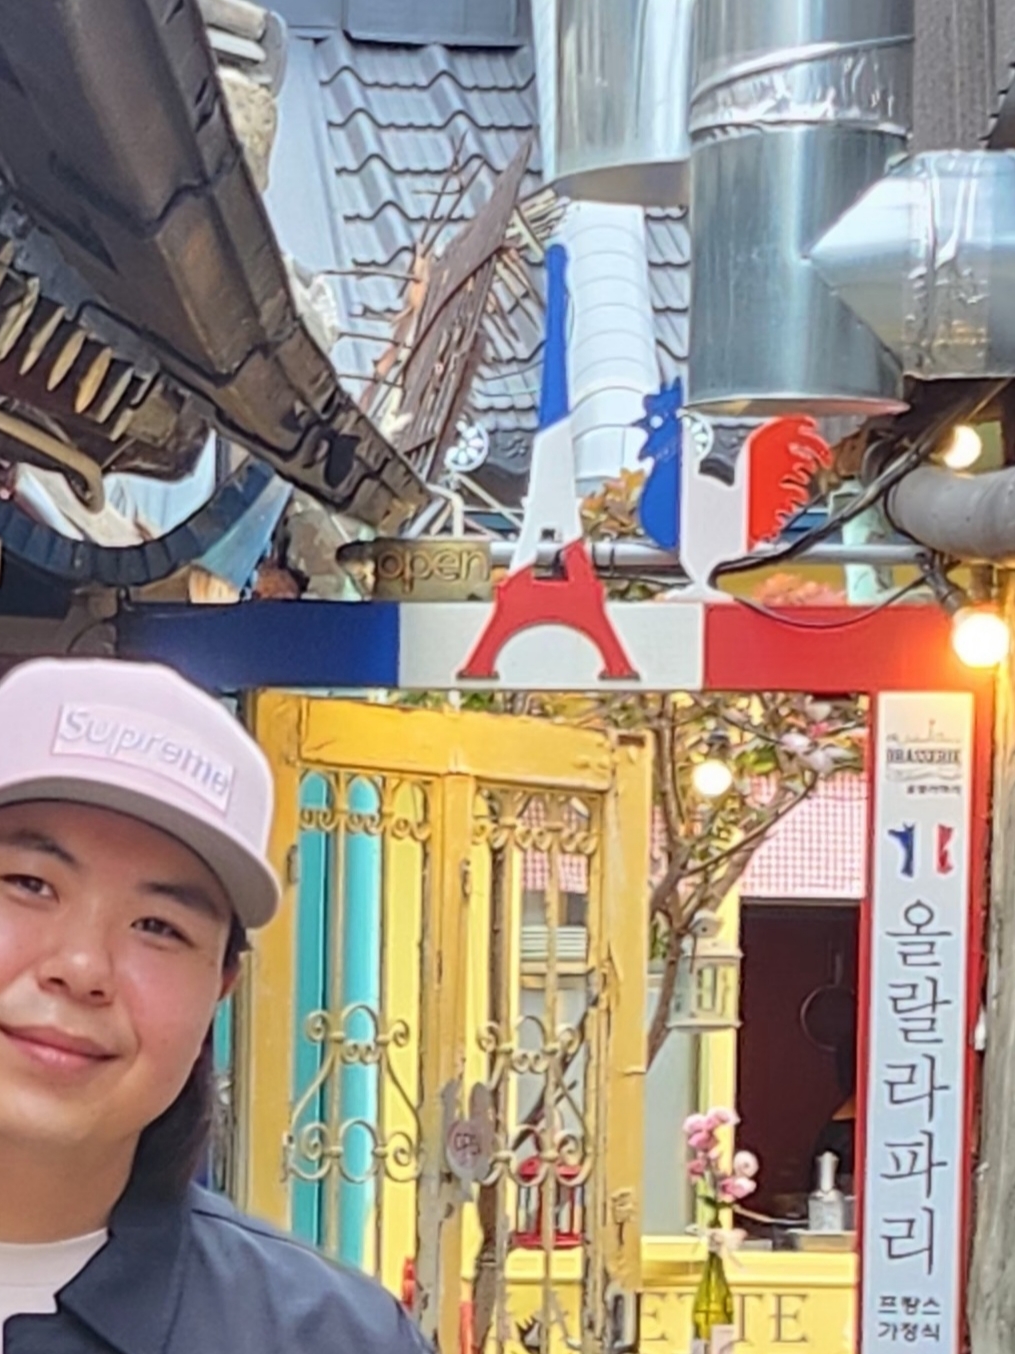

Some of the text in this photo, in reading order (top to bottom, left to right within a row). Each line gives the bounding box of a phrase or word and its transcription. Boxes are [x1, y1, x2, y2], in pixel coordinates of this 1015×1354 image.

[378, 547, 490, 593] open
[59, 710, 230, 797] Supreme
[879, 899, 953, 1275] 올랄라파리
[878, 1295, 941, 1316] 프랑스
[878, 1321, 941, 1342] 가정식
